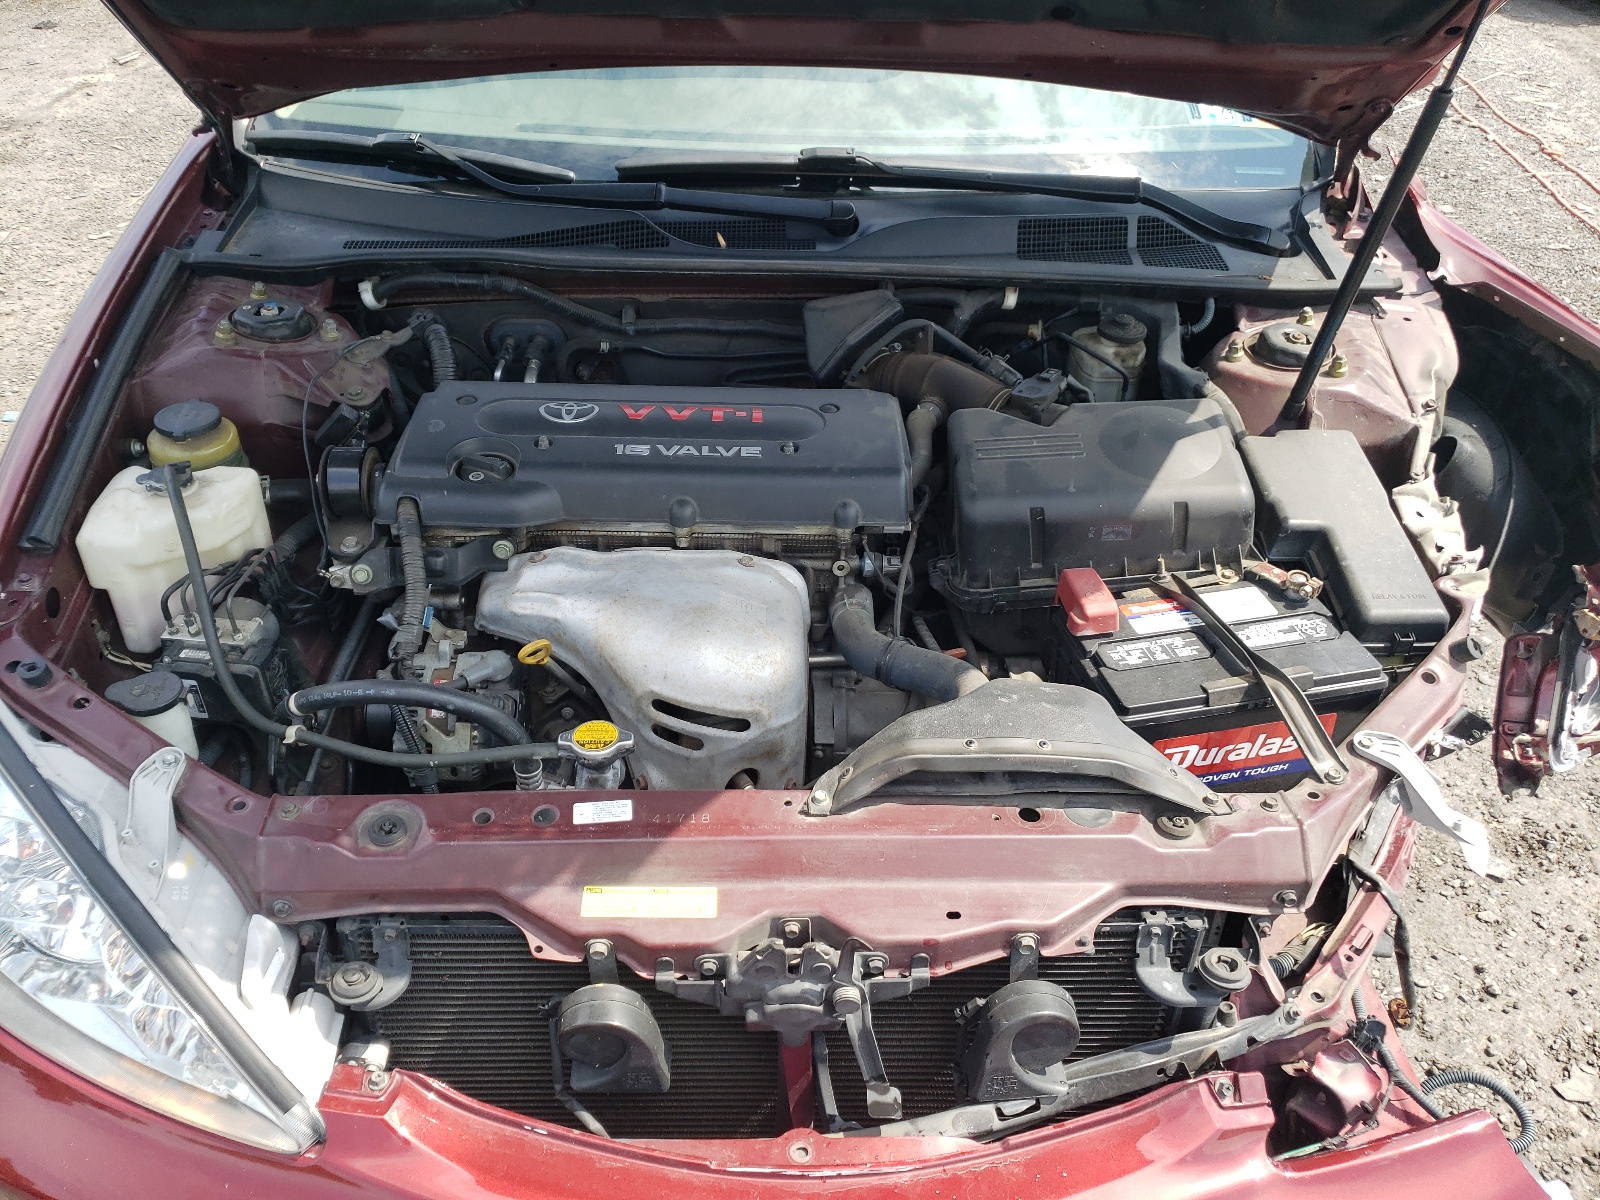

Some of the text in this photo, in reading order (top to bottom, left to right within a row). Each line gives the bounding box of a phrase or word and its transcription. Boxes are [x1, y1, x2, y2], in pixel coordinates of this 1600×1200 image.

[614, 443, 763, 459] 16 VALVE
[1164, 733, 1298, 769] Duralas
[1199, 763, 1289, 784] OVEN TOUGH
[652, 813, 711, 823] 41718
